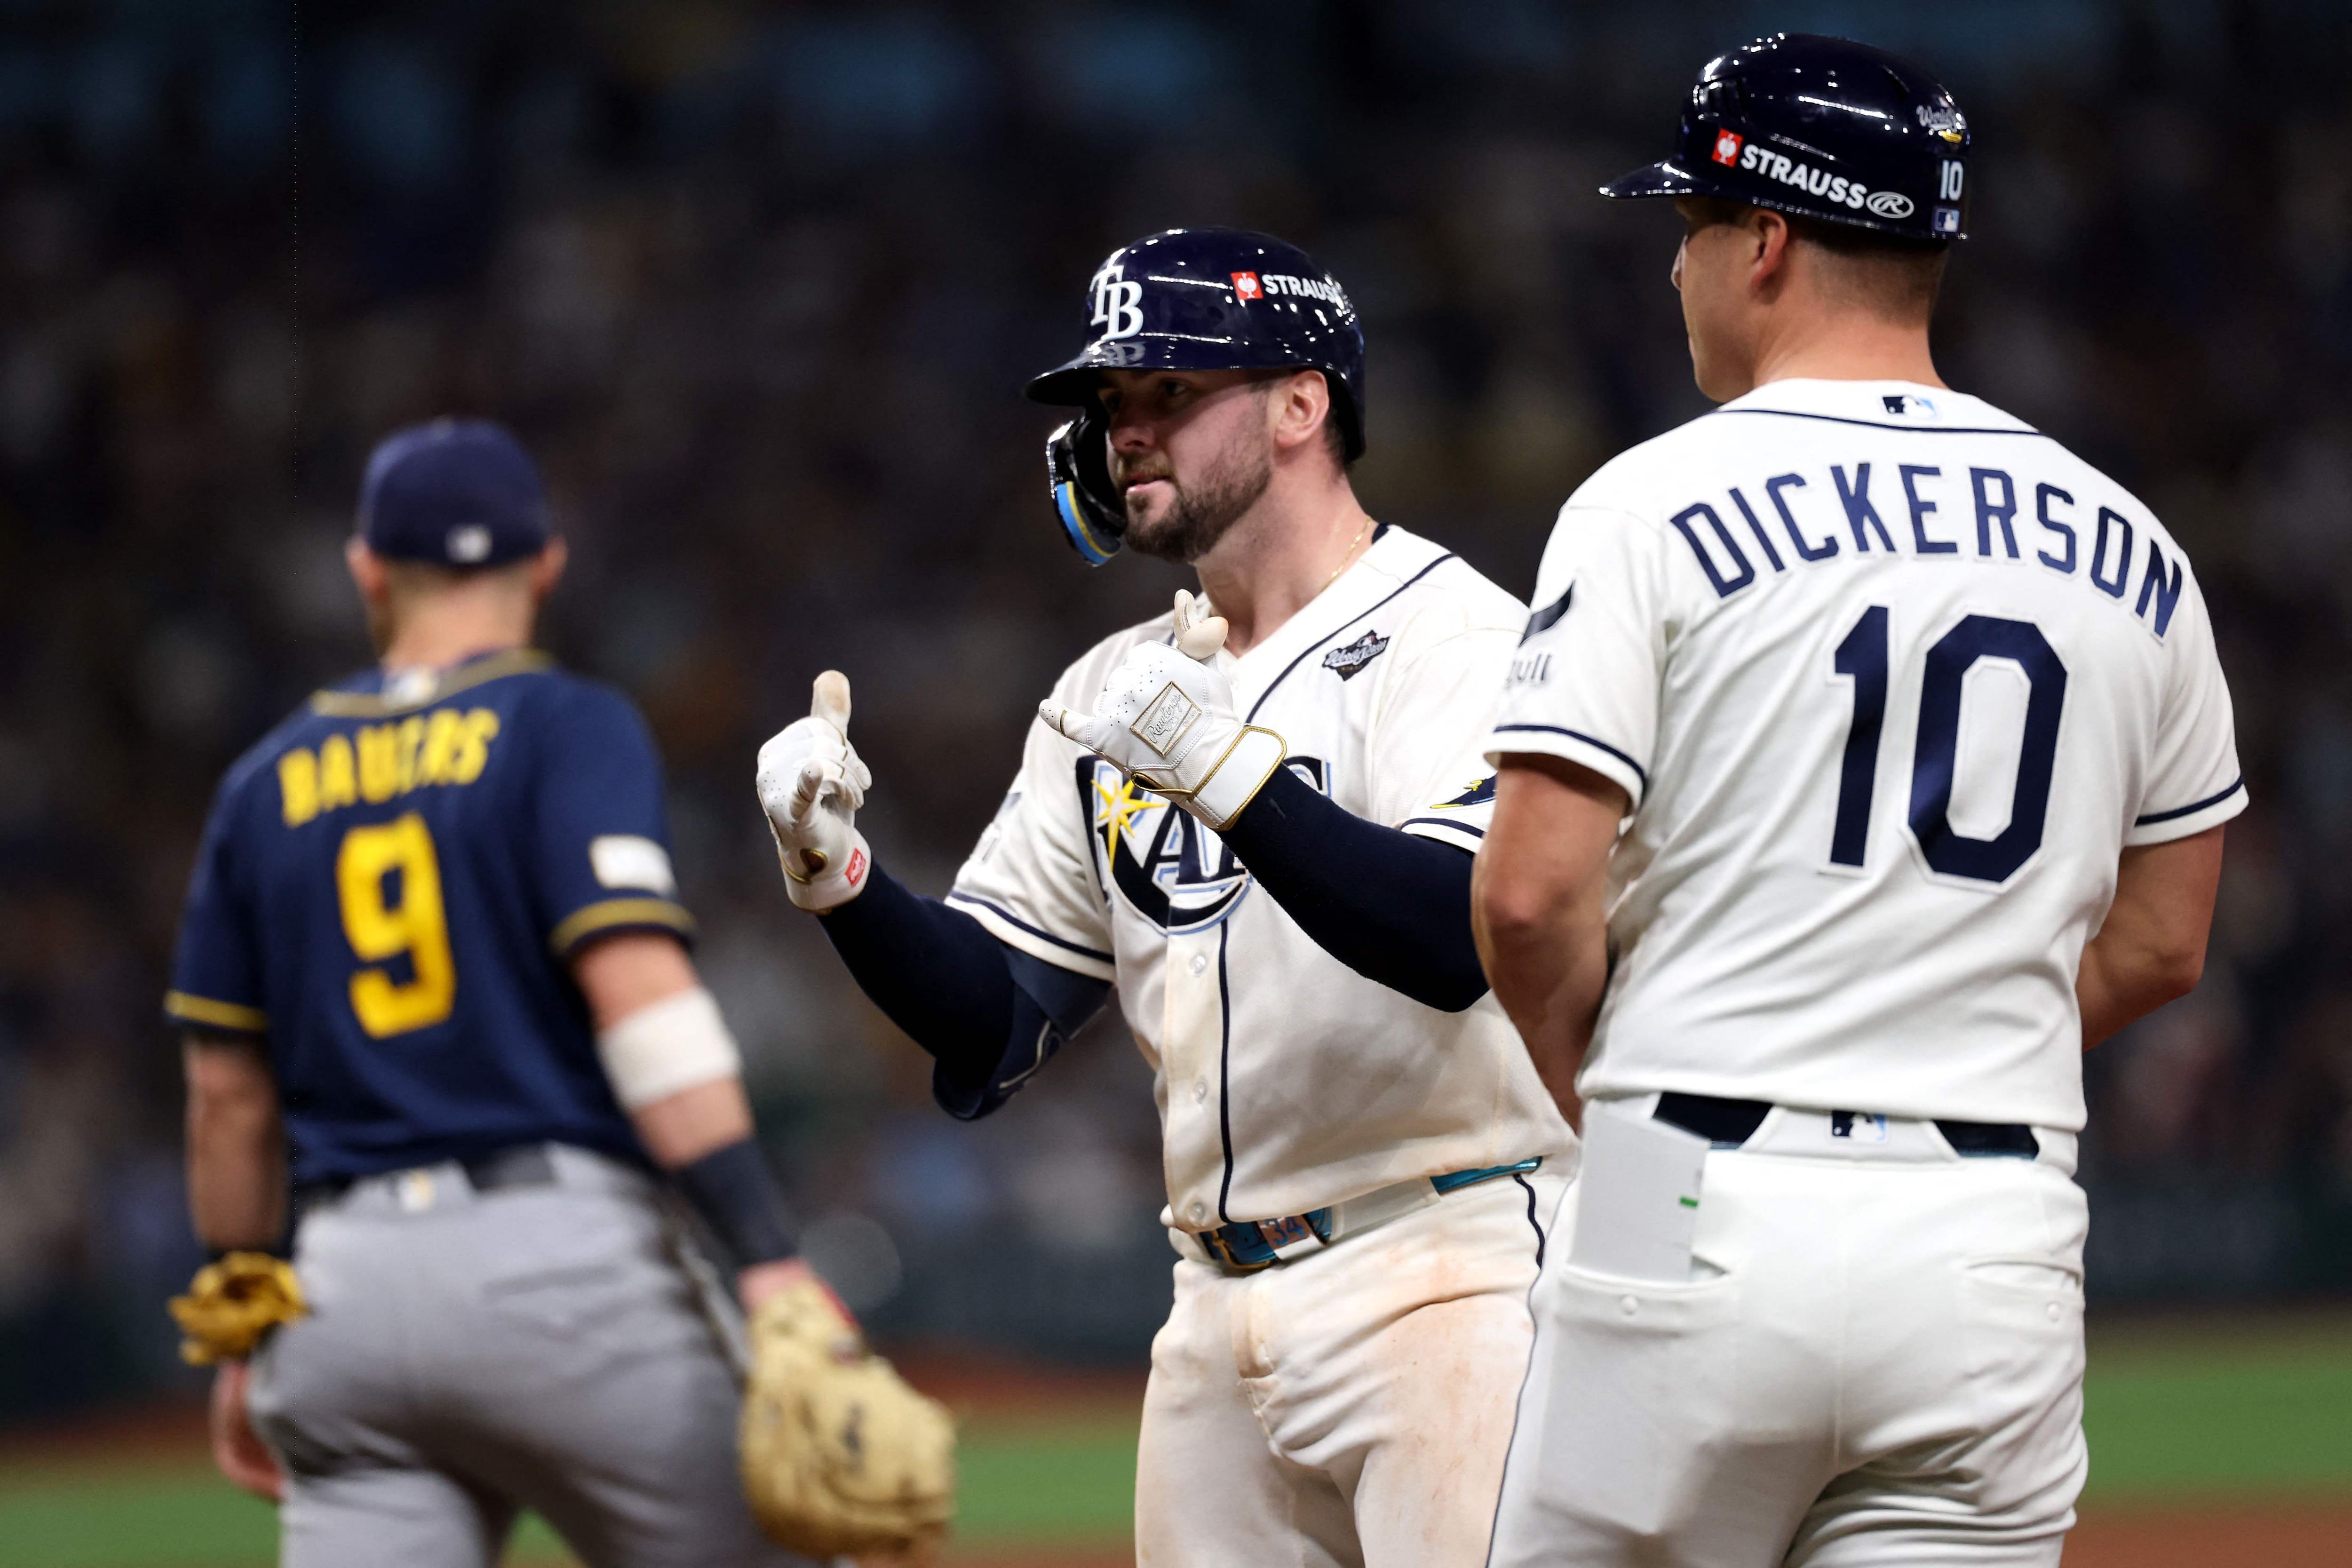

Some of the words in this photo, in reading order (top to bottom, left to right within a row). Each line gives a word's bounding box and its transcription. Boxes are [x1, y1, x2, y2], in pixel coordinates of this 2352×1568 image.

[1740, 144, 1867, 209] STRAUSS
[1939, 159, 1964, 201] 10
[1089, 264, 1144, 341] TB
[1262, 274, 1342, 304] STRAUS
[1669, 462, 2183, 638] DICKERSON
[1828, 605, 2068, 883] 10
[336, 812, 455, 1038] 9
